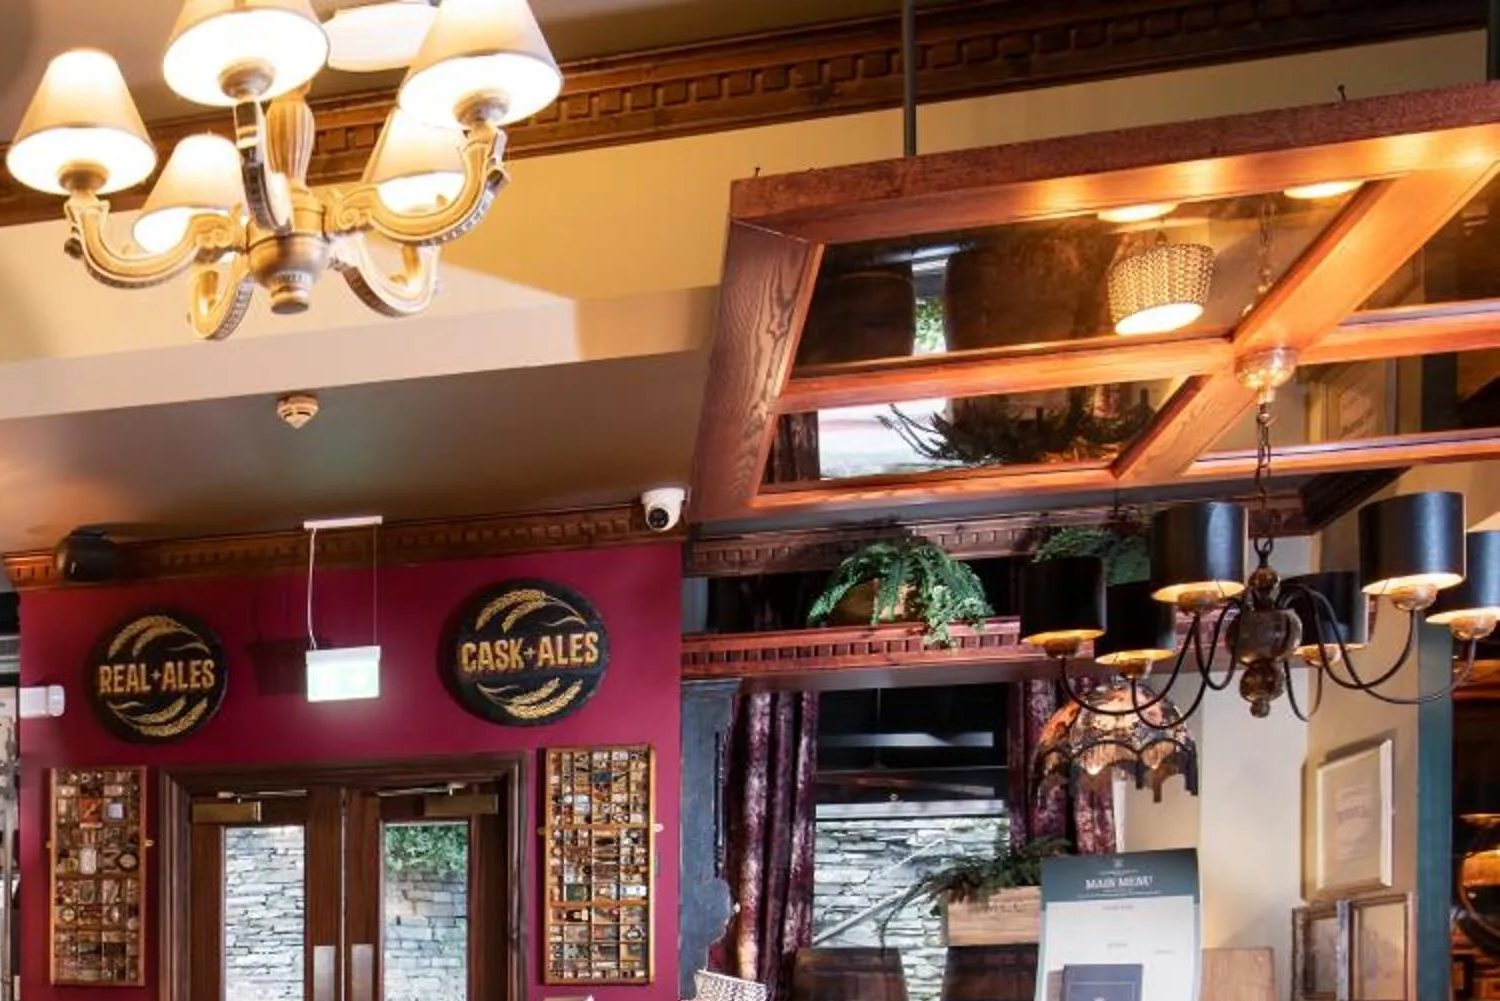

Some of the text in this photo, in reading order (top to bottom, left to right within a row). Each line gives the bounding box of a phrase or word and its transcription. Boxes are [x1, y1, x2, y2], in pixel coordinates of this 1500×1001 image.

[461, 631, 599, 672] CASK ALES
[99, 660, 215, 693] REAL ALES
[1085, 877, 1116, 891] MAIN
